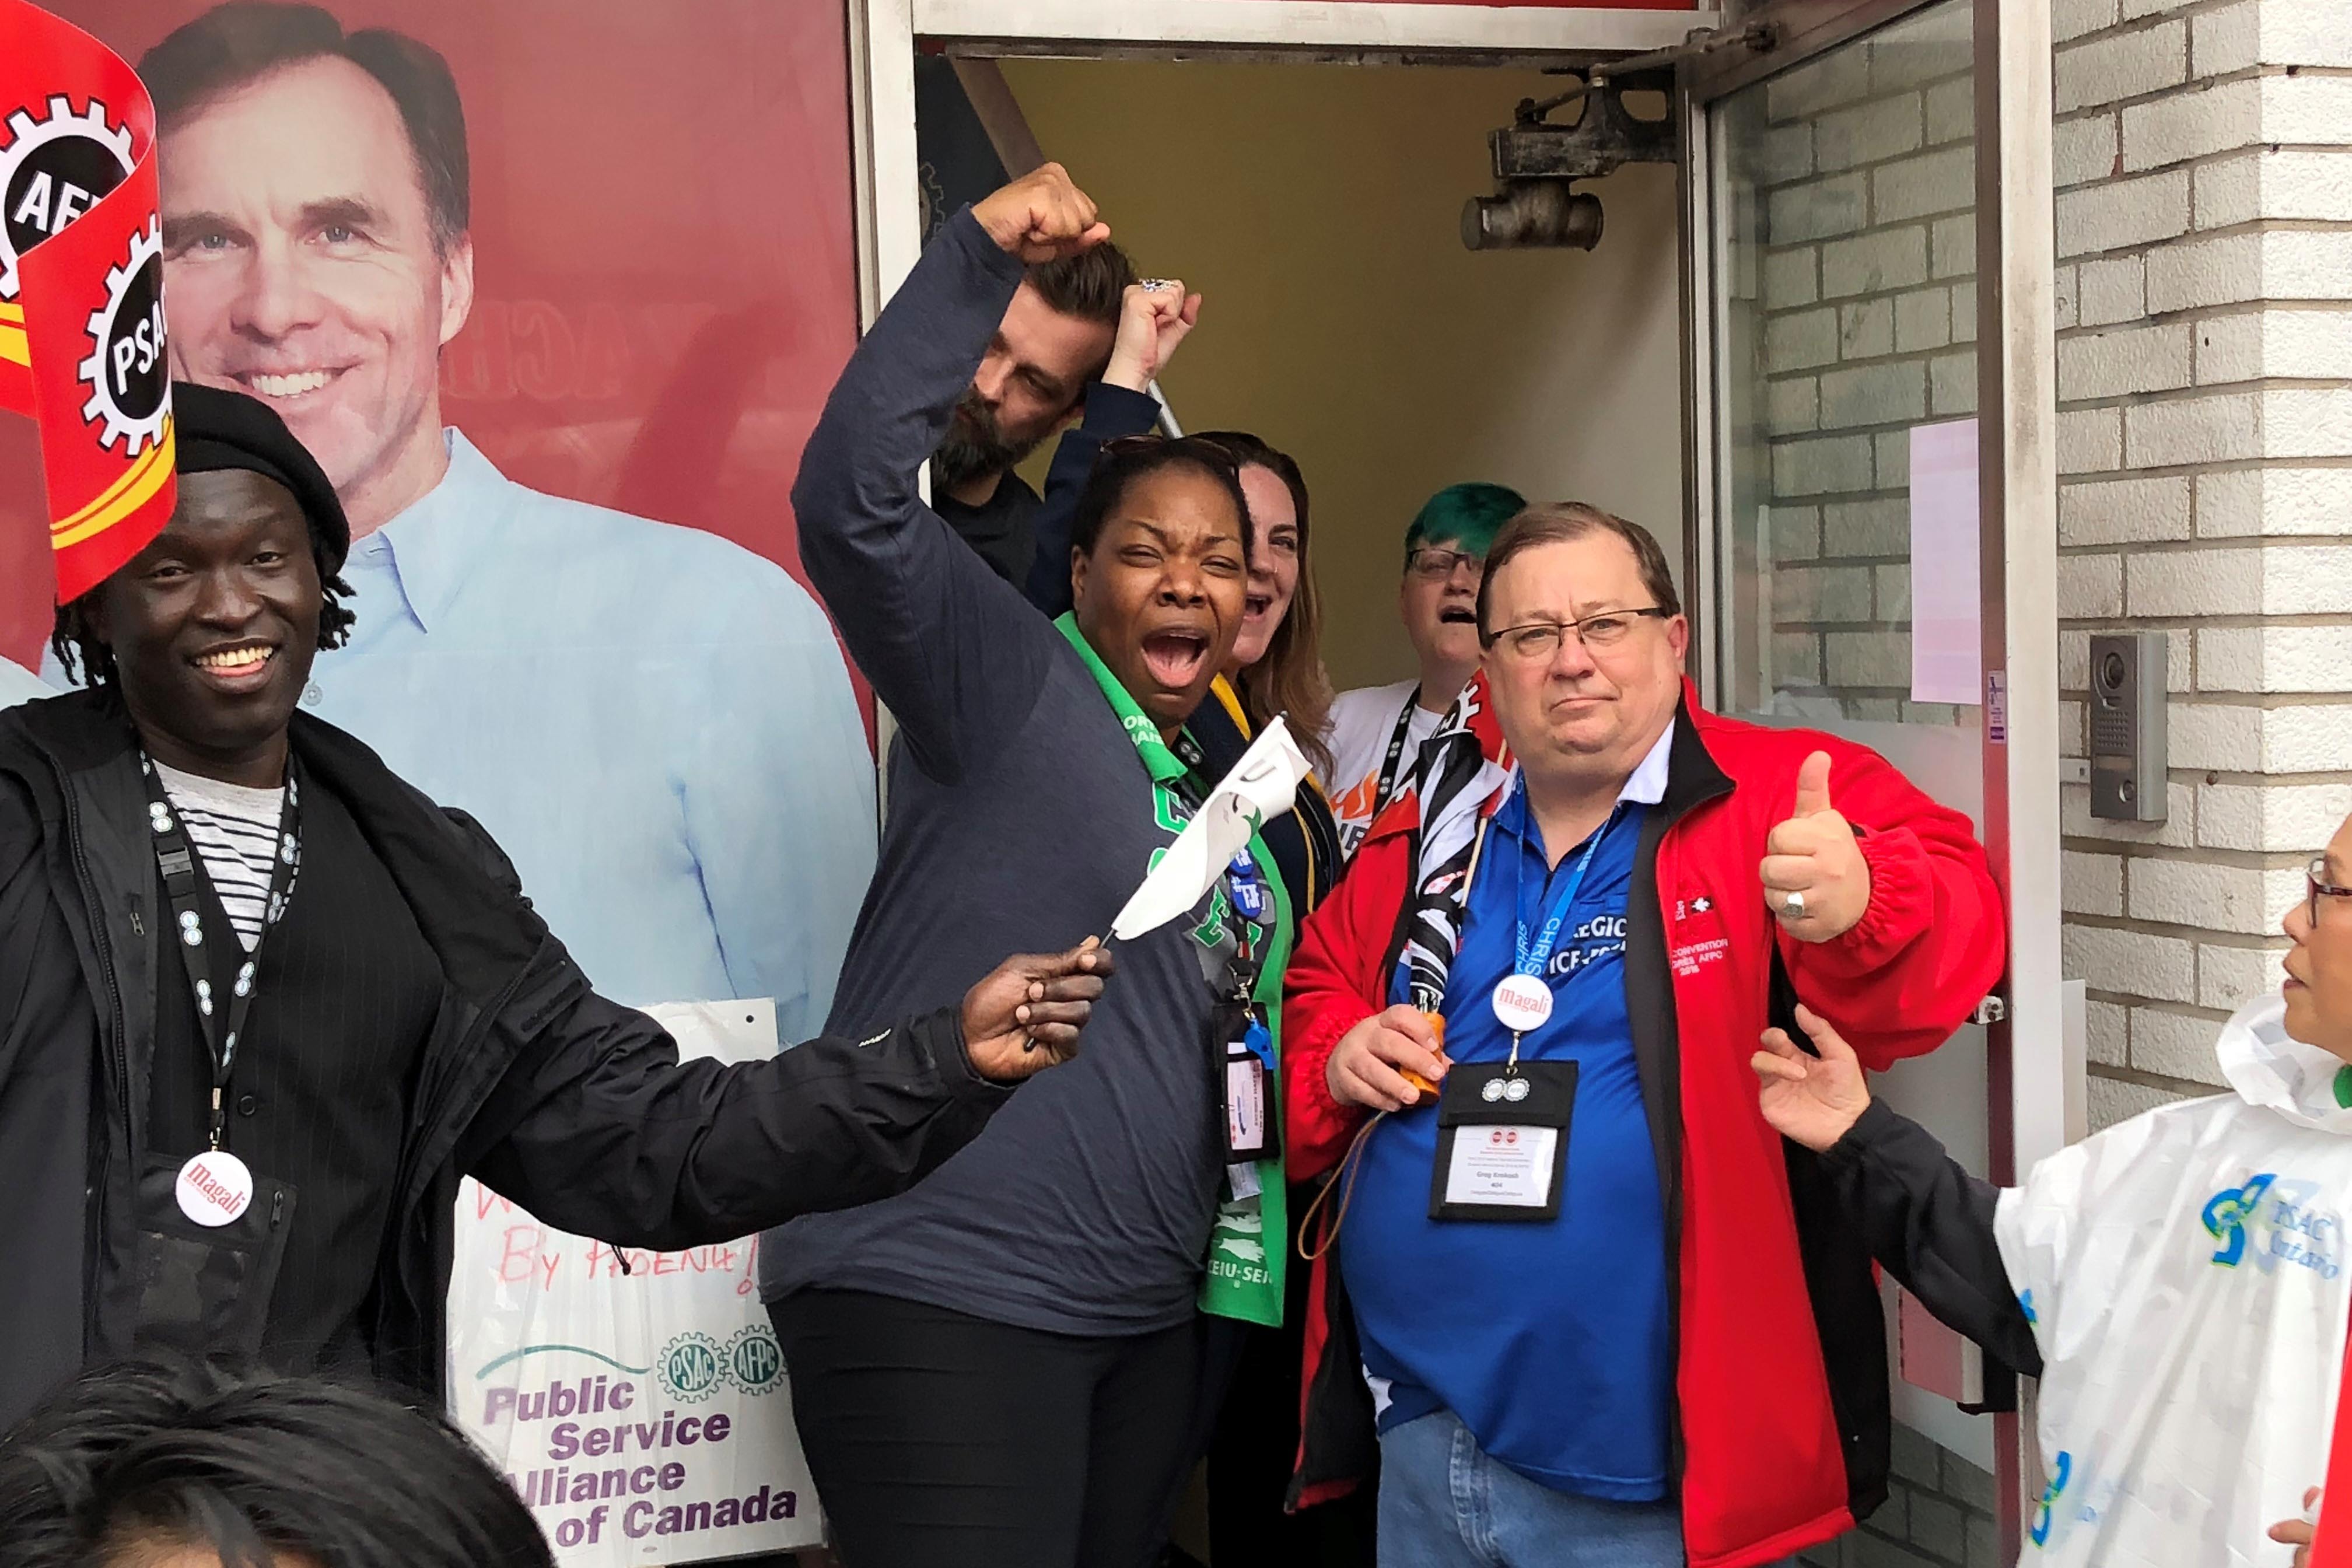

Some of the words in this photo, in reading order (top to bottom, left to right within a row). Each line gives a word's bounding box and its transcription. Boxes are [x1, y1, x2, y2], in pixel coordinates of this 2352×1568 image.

[13, 170, 104, 235] AF
[1525, 918, 1561, 976] CHRIS
[1499, 988, 1549, 1014] magali
[187, 1163, 246, 1215] magali
[671, 1346, 712, 1389] PSAC
[738, 1340, 775, 1381] AFPC
[483, 1375, 635, 1426] Public
[548, 1410, 731, 1460] Service
[555, 1505, 609, 1547] of
[622, 1485, 797, 1539] Canada
